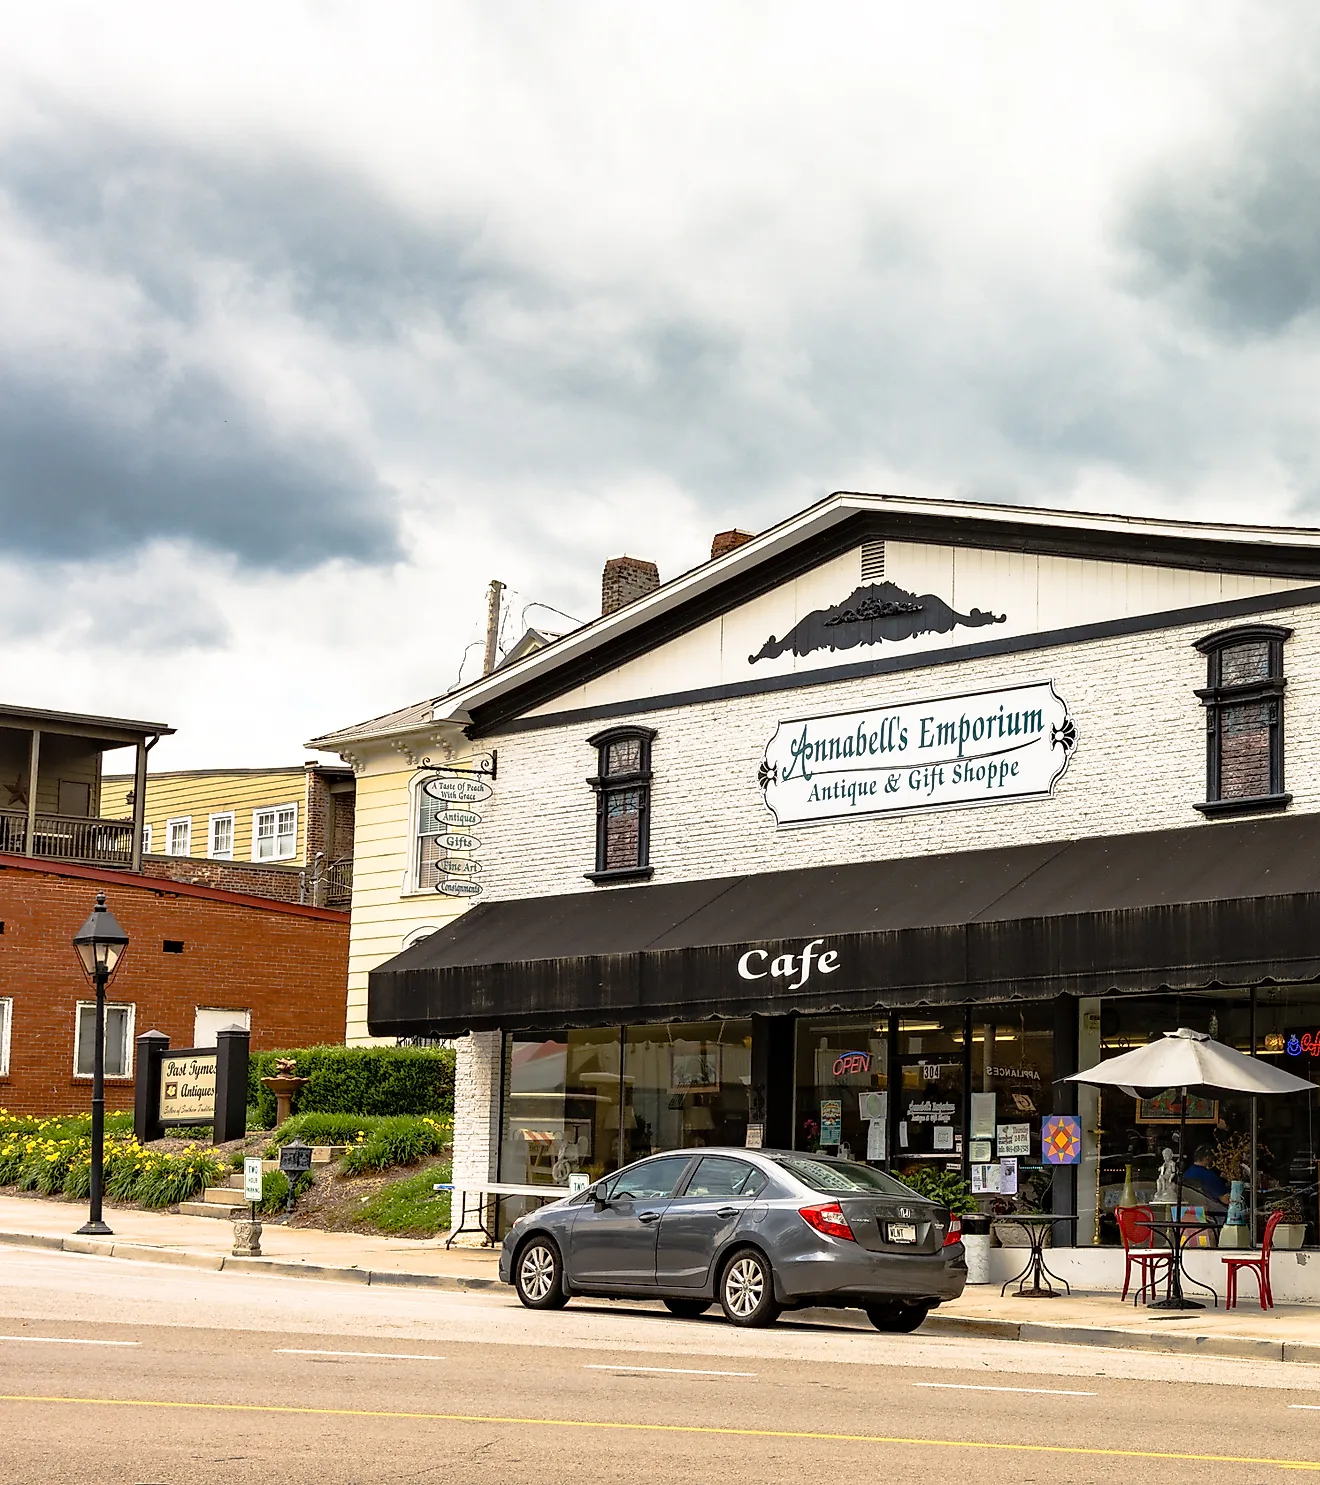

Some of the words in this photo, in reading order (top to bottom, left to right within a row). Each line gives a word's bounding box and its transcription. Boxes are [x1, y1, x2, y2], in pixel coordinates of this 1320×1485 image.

[782, 716, 908, 781] Annabell's
[918, 705, 1044, 757] Emporium
[439, 782, 455, 790] Taste
[457, 782, 465, 791] Of
[807, 778, 877, 806] Antique
[884, 774, 901, 794] &
[909, 764, 945, 797] Gift
[953, 761, 1019, 789] Shoppe
[441, 791, 457, 799] With
[458, 792, 476, 800] Grace
[442, 812, 476, 826] Antiques
[446, 836, 472, 850] Gifts
[443, 861, 461, 871] Fine
[463, 862, 477, 872] Art
[441, 882, 480, 895] Consignments
[738, 939, 840, 989] Cafe
[166, 1061, 186, 1077] Past
[832, 1056, 870, 1076] OPEN
[924, 1065, 939, 1079] 304
[181, 1083, 215, 1101] Antiques
